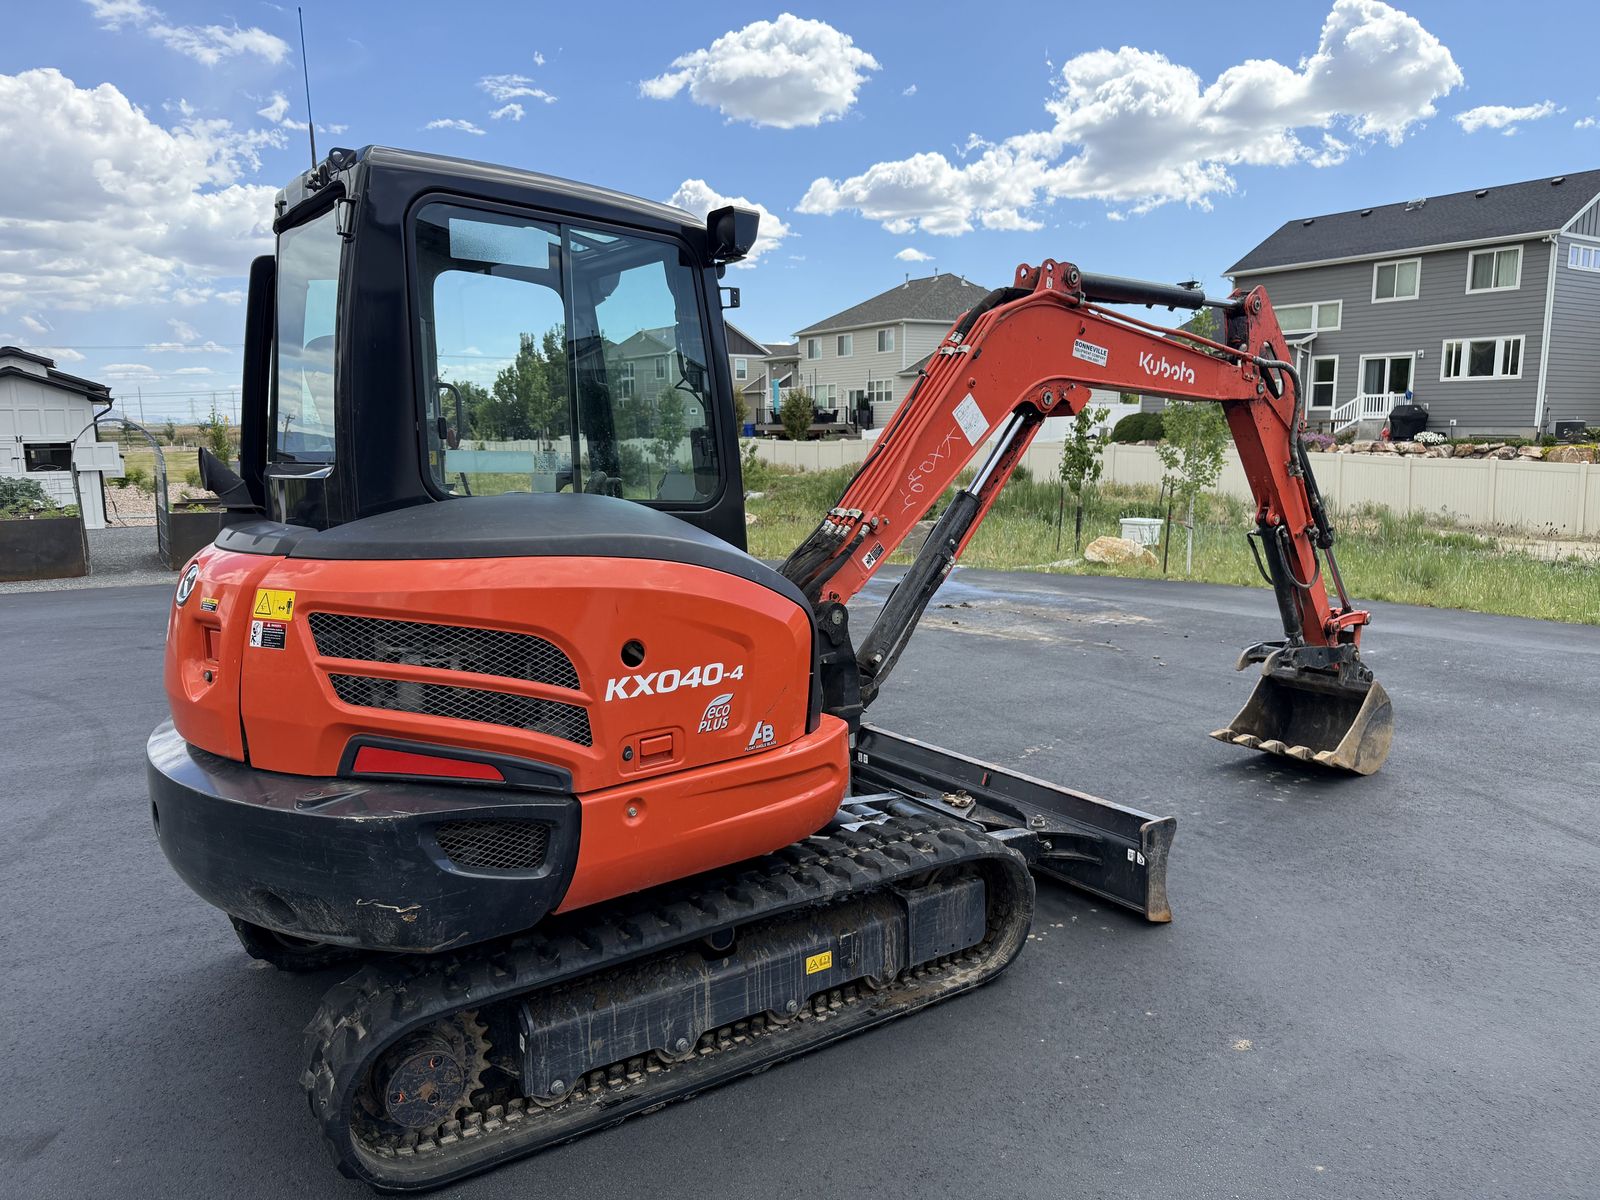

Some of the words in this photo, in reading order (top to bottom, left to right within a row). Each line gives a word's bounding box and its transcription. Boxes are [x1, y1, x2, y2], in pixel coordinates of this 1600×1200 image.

[1075, 341, 1107, 356] BONNEVILLE
[1139, 352, 1194, 384] Kubota
[605, 662, 743, 701] KX040-4
[707, 704, 731, 719] eco
[698, 716, 729, 734] PLUS
